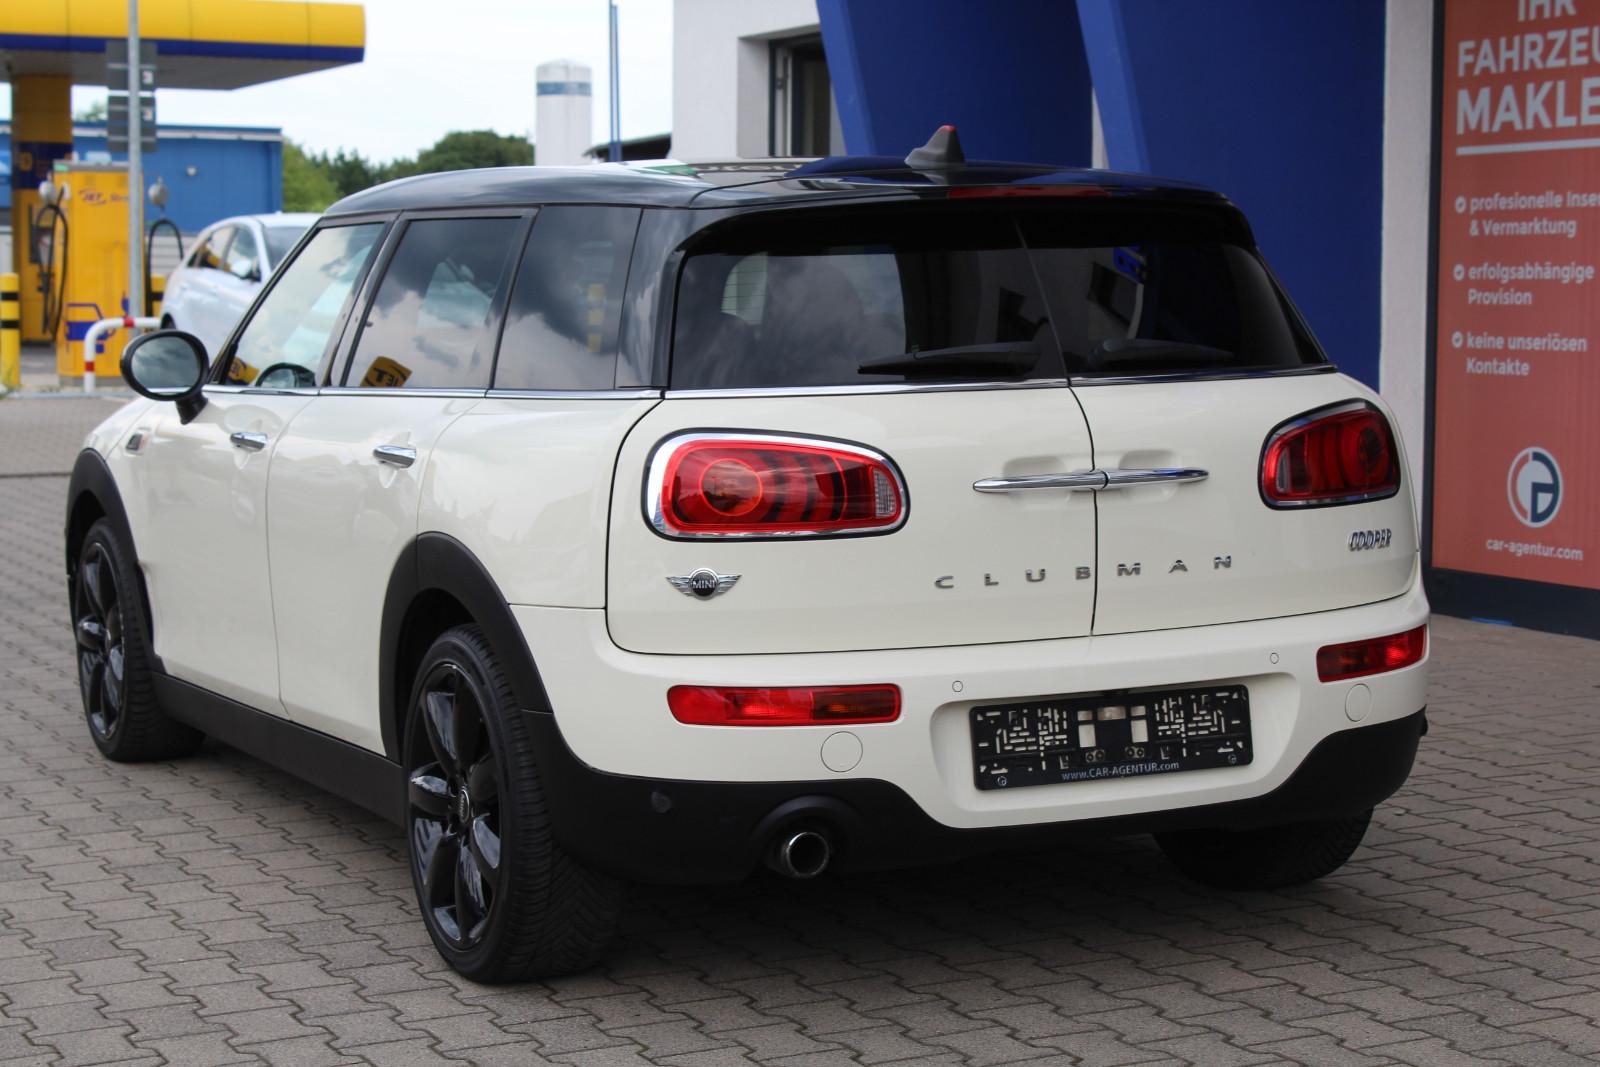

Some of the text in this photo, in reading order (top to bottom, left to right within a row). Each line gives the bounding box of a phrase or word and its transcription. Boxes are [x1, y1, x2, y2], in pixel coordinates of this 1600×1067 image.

[1469, 189, 1600, 214] profesionelle Inse
[1469, 216, 1577, 239] & Vermarktung
[1468, 261, 1595, 285] erfolgsabhängige
[1467, 287, 1533, 305] Provision
[1466, 331, 1588, 352] keine unseriösen
[1466, 356, 1531, 376] Kontakte
[1347, 528, 1393, 552] COOPER
[1486, 539, 1584, 561] car-agentur.com
[934, 555, 1232, 589] CLUBMAN
[692, 579, 715, 589] MINI
[1061, 760, 1180, 780] www.CAR-AGENTUR.com
